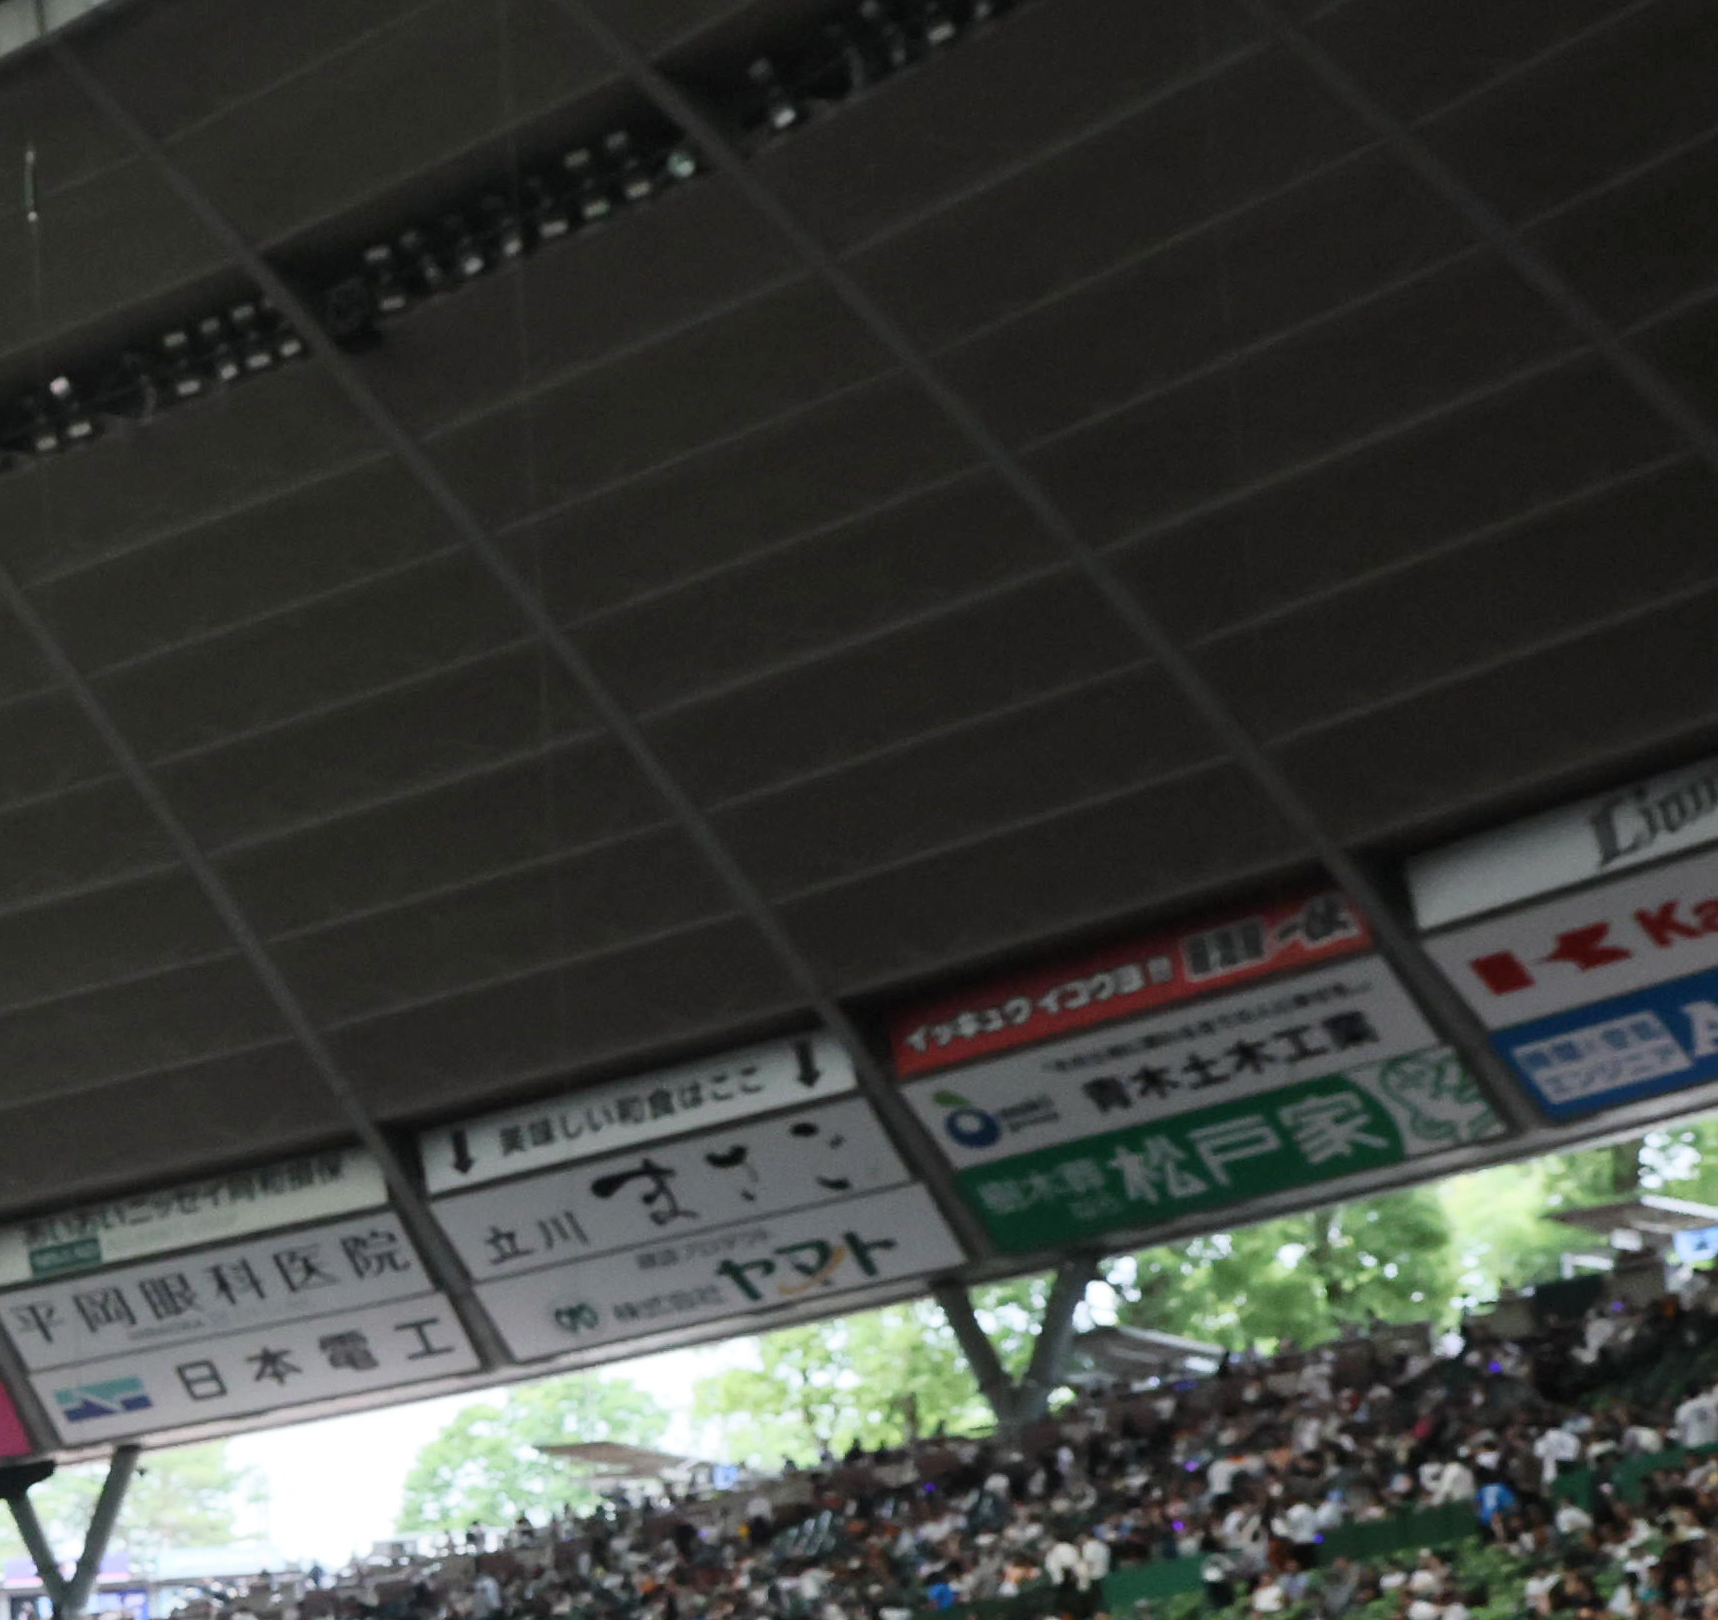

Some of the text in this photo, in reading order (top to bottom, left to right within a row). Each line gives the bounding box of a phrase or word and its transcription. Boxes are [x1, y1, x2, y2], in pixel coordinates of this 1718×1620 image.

[497, 1066, 769, 1158] 美味しい和食はここ
[485, 1210, 590, 1265] 立川
[716, 1229, 901, 1301] ヤマト
[10, 1230, 411, 1343] 平岡眼科医院
[174, 1316, 455, 1400] 日本電工
